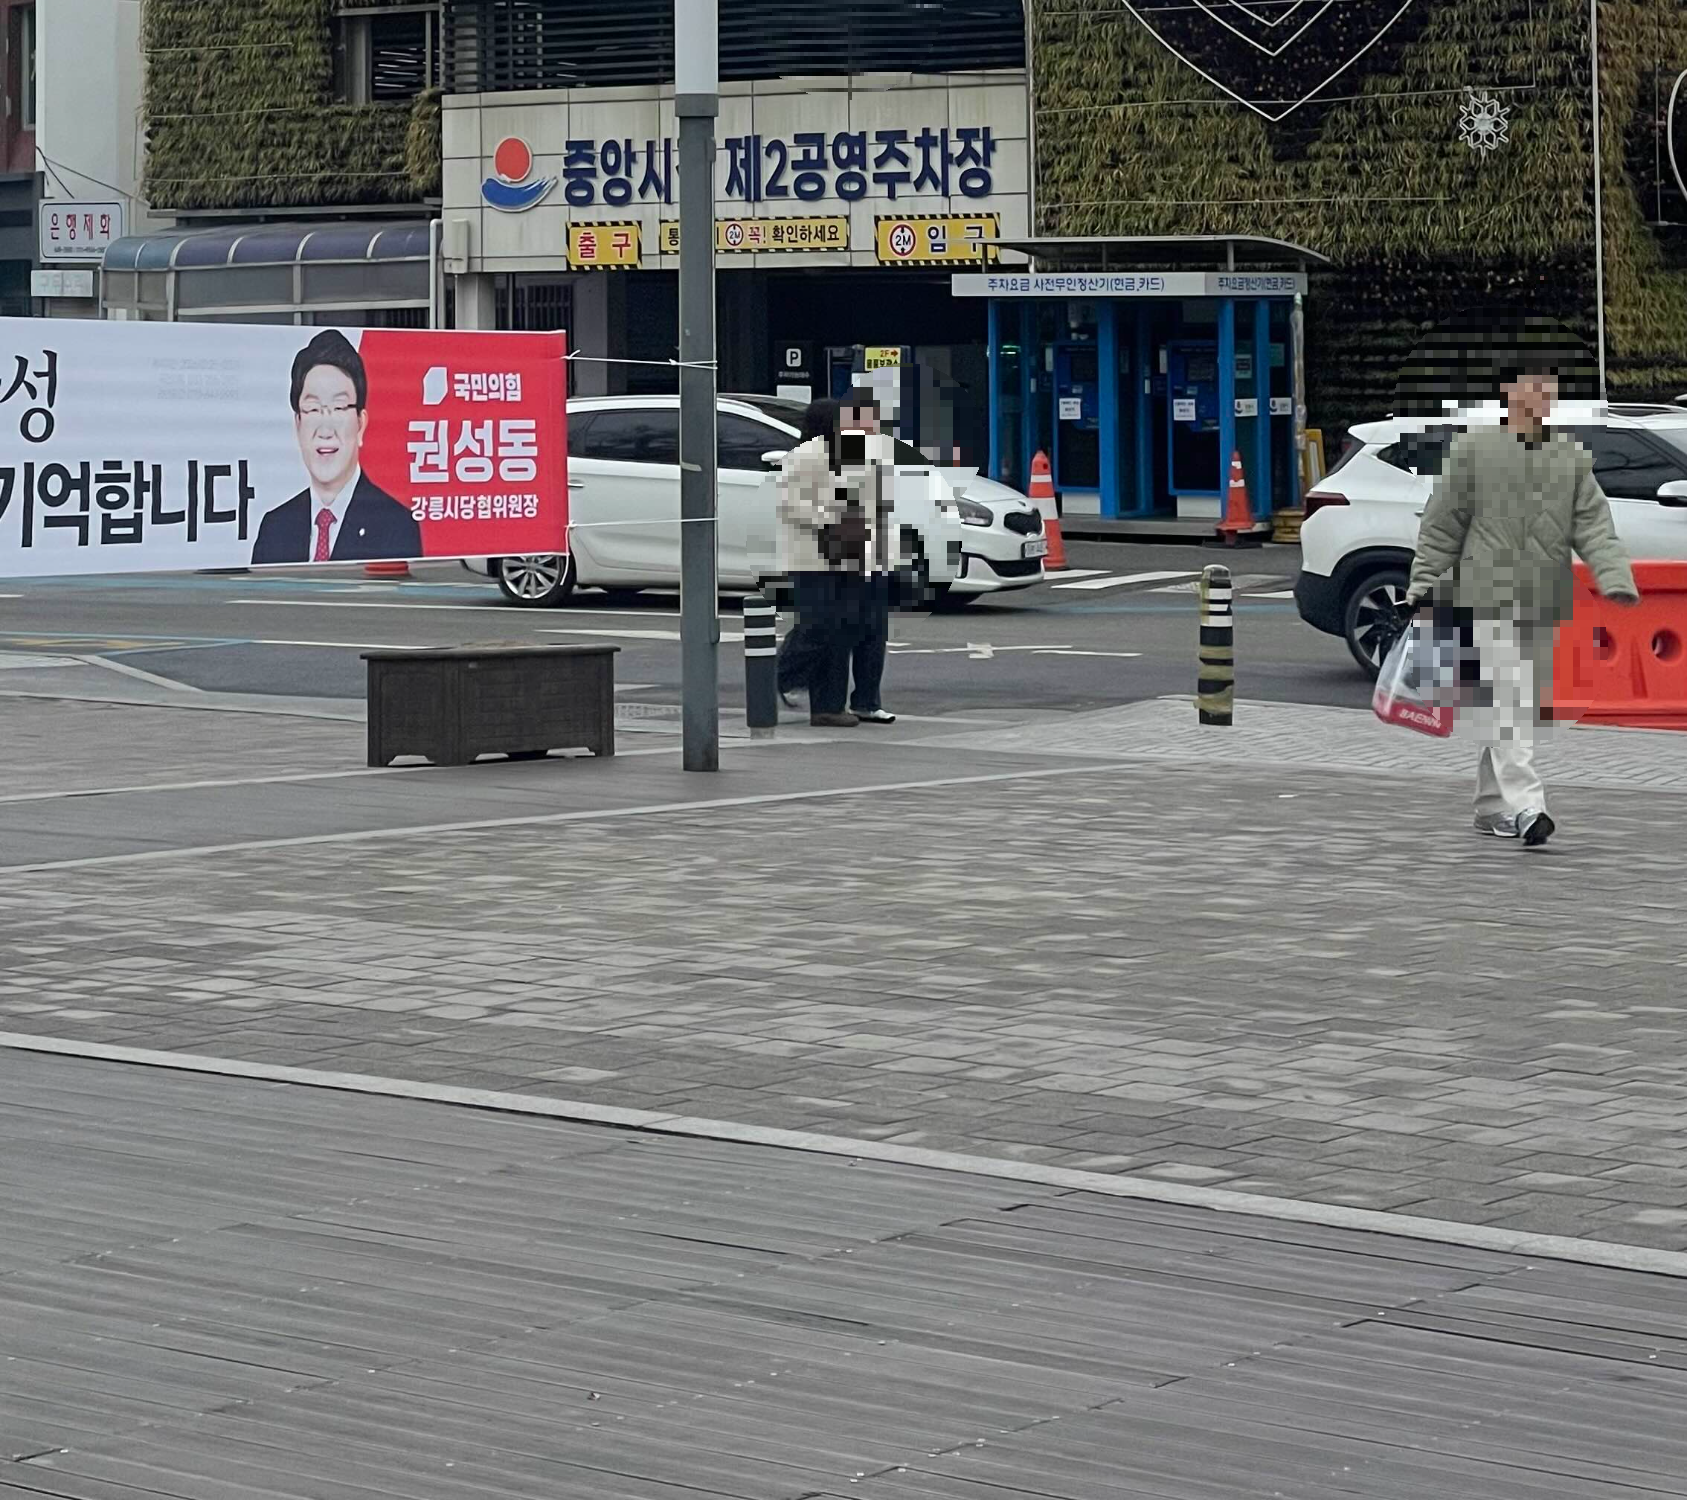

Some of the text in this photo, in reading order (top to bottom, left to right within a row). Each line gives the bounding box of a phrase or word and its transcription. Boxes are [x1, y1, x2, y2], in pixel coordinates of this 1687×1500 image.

[563, 127, 996, 206] 중앙시 제2공영주차장
[578, 231, 631, 259] 출구
[748, 227, 767, 244] 꼭!
[772, 225, 840, 244] 확인하세요
[895, 235, 911, 247] 2M
[0, 350, 58, 443] 성
[453, 372, 522, 402] 국민의힘
[406, 419, 538, 483] 권성동
[0, 460, 255, 548] 기억합니다
[411, 493, 539, 521] 강릉시당협위원장
